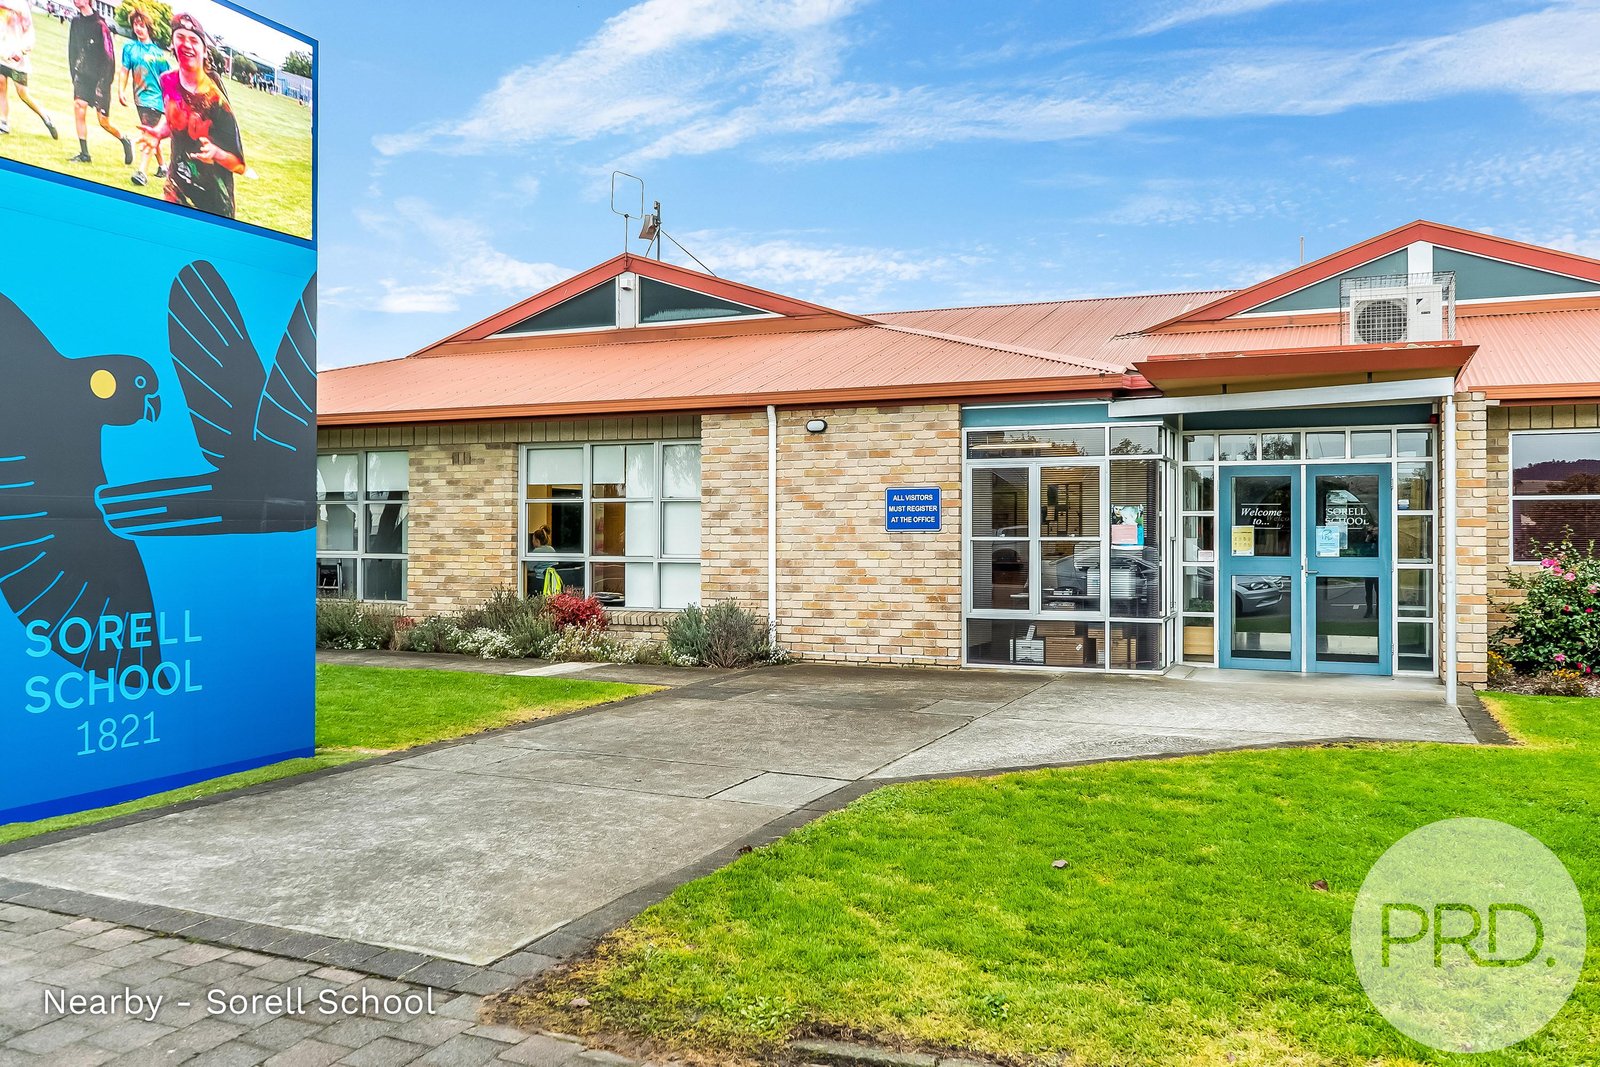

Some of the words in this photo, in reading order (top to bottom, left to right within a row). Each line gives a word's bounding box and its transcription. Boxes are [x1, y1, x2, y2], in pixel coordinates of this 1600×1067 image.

[1241, 507, 1282, 516] Welcome
[1327, 508, 1367, 516] SORELL
[25, 610, 202, 658] SORELL
[25, 660, 202, 714] SCHOOL
[77, 711, 161, 756] 1821
